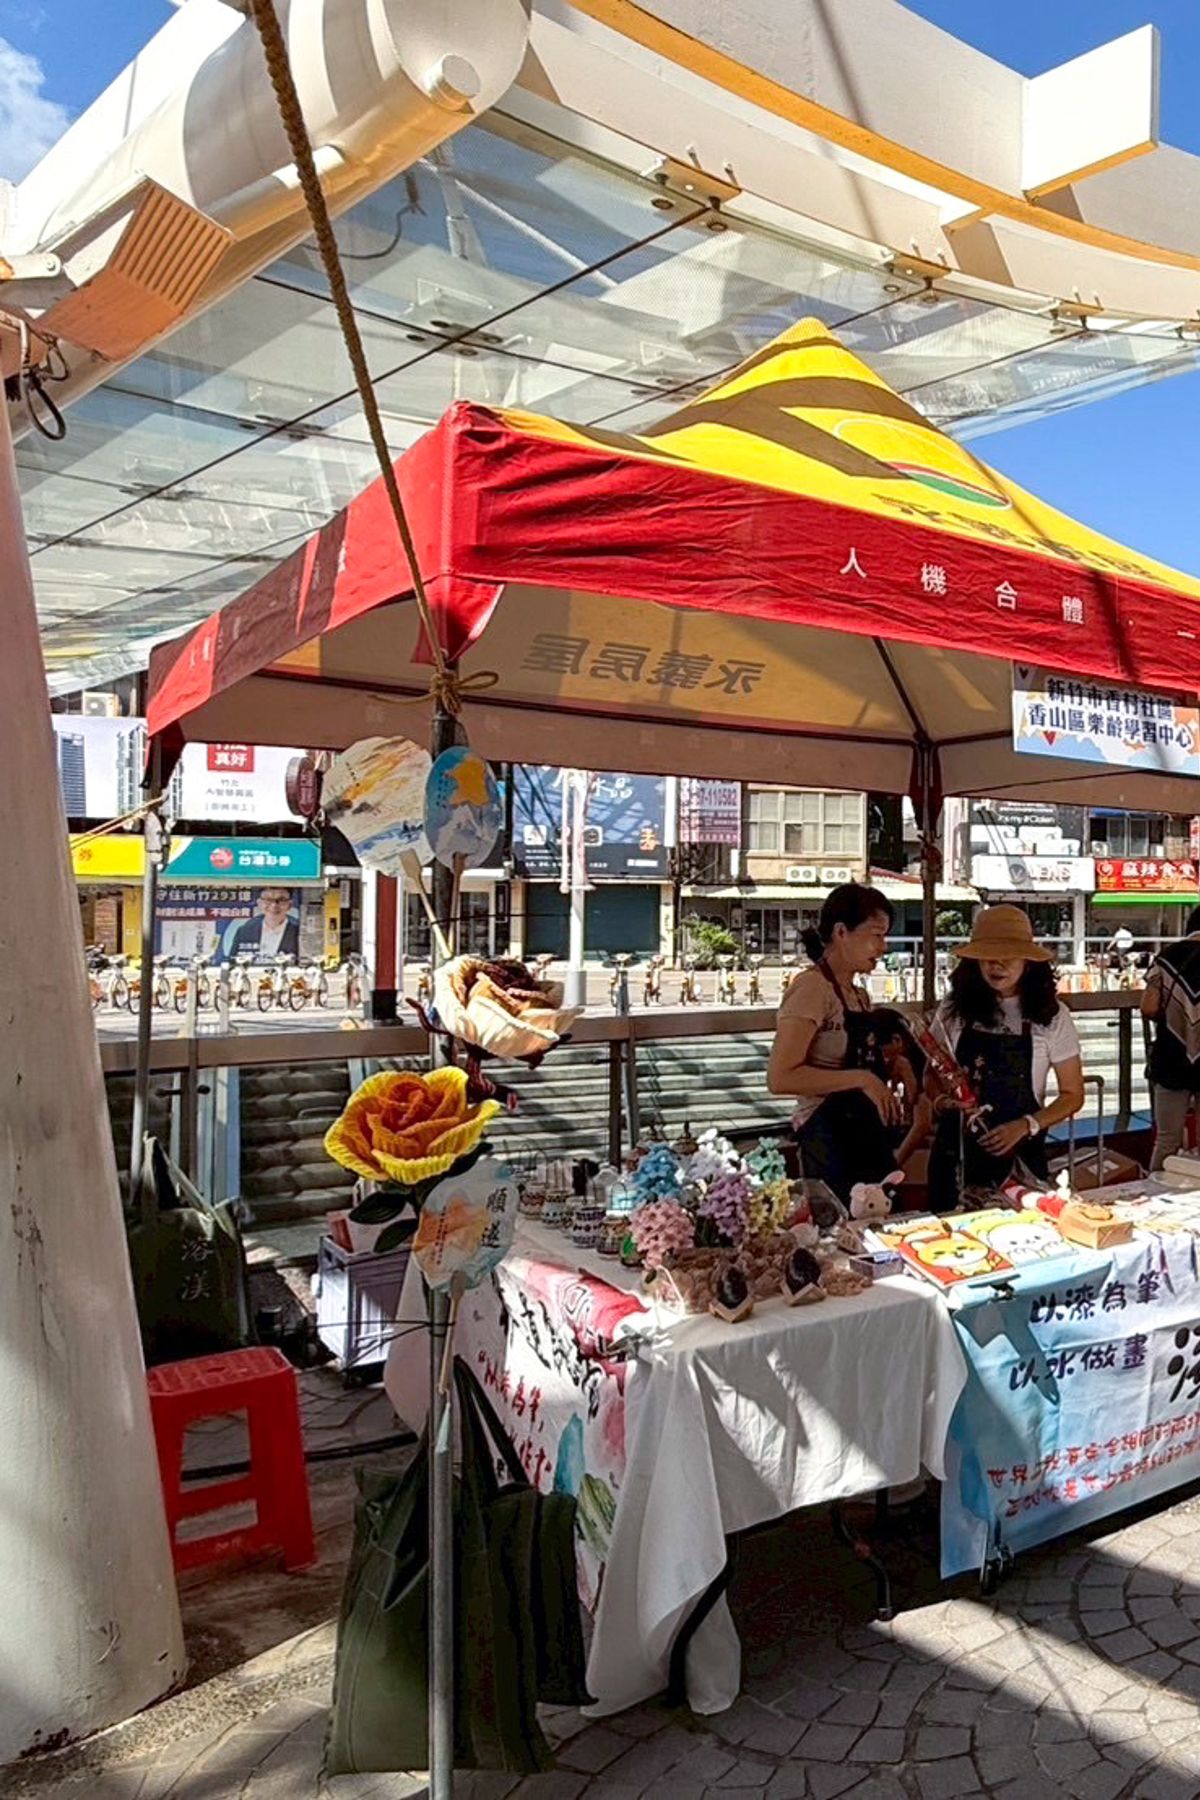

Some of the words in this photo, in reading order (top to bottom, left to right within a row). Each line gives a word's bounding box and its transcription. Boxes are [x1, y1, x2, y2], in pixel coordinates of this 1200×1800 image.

[840, 547, 1084, 624] 人機合體
[1047, 678, 1173, 720] 新竹市香村社區
[1028, 703, 1192, 748] 香山區樂齡學習中心
[239, 855, 291, 866] 台灣彩券
[1030, 1271, 1162, 1324] 以漆為筆
